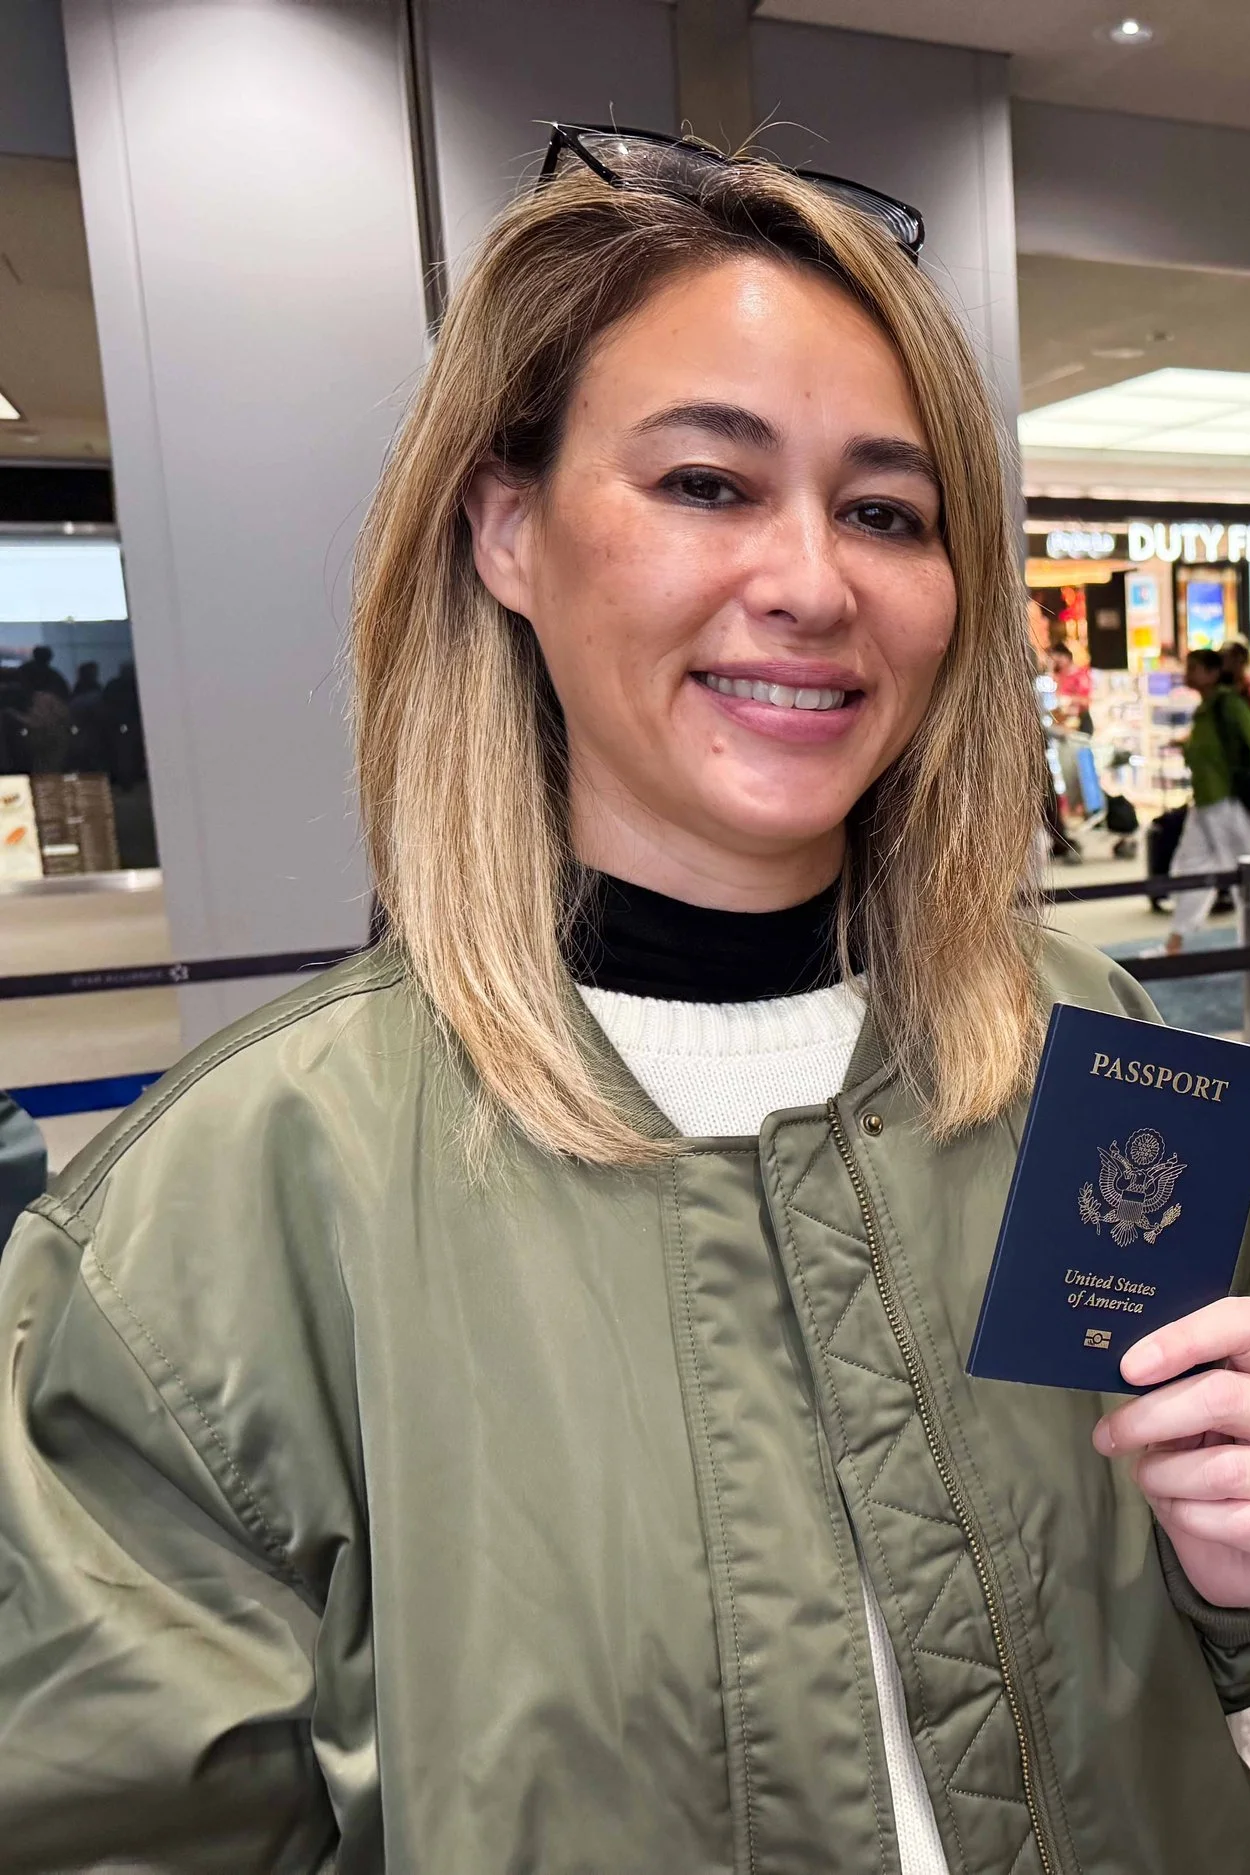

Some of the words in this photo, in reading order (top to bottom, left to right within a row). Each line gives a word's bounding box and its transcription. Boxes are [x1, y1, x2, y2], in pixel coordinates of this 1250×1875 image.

[1128, 522, 1225, 562] DUTY
[1089, 1052, 1230, 1103] PASSPORT
[1064, 1268, 1113, 1291] United
[1114, 1277, 1157, 1297] States
[1067, 1289, 1086, 1309] of
[1085, 1293, 1144, 1315] America
